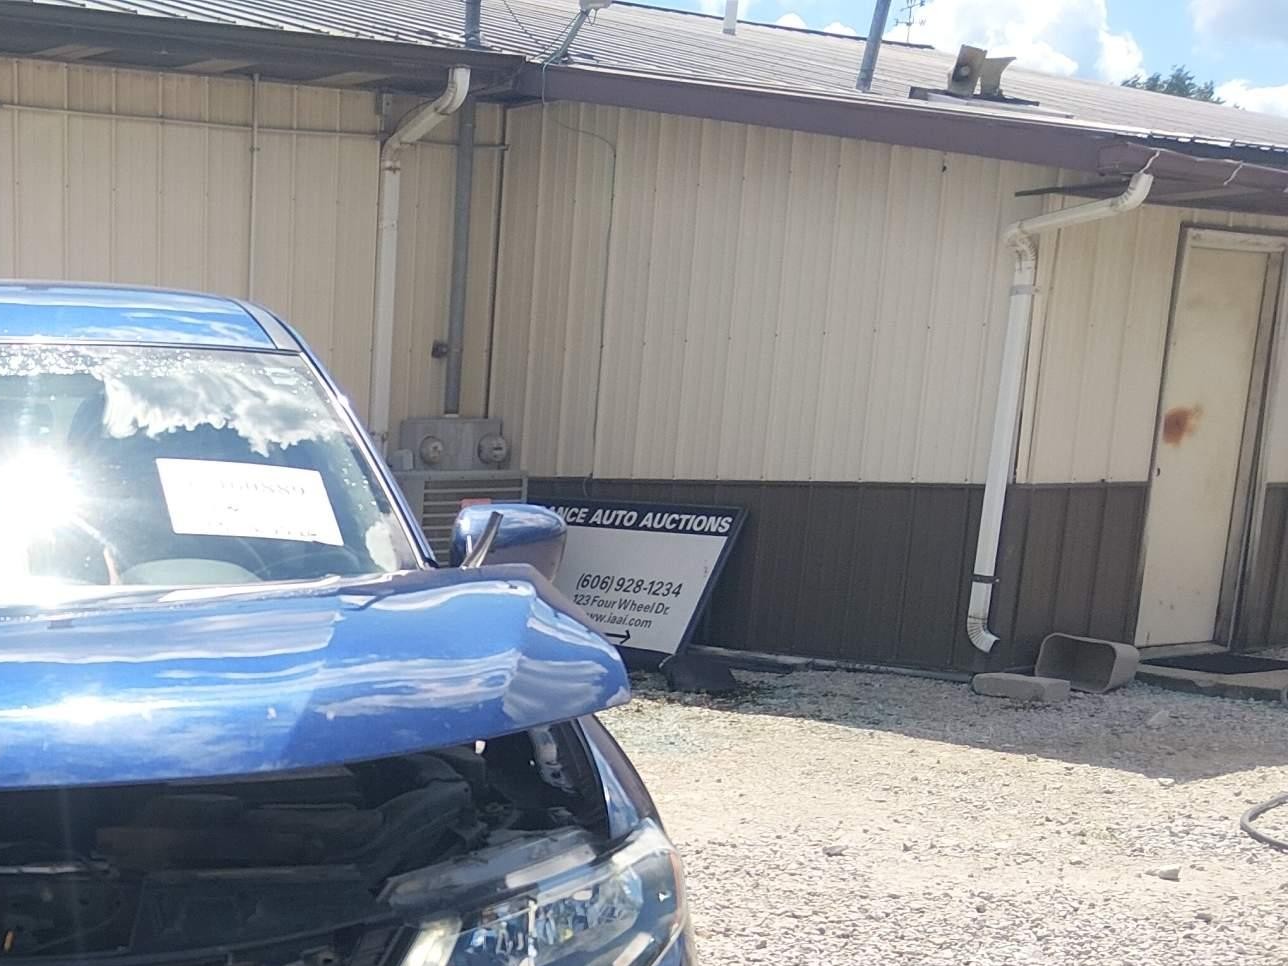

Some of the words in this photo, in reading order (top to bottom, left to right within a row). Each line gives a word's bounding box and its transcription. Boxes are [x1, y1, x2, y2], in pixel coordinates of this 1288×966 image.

[589, 509, 638, 527] AUTO
[639, 513, 733, 533] AUCTIONS
[576, 573, 614, 593] (606)
[614, 578, 683, 598] 928-1234
[573, 594, 592, 606] 123
[590, 596, 617, 609] Four
[617, 599, 654, 613] Wheel
